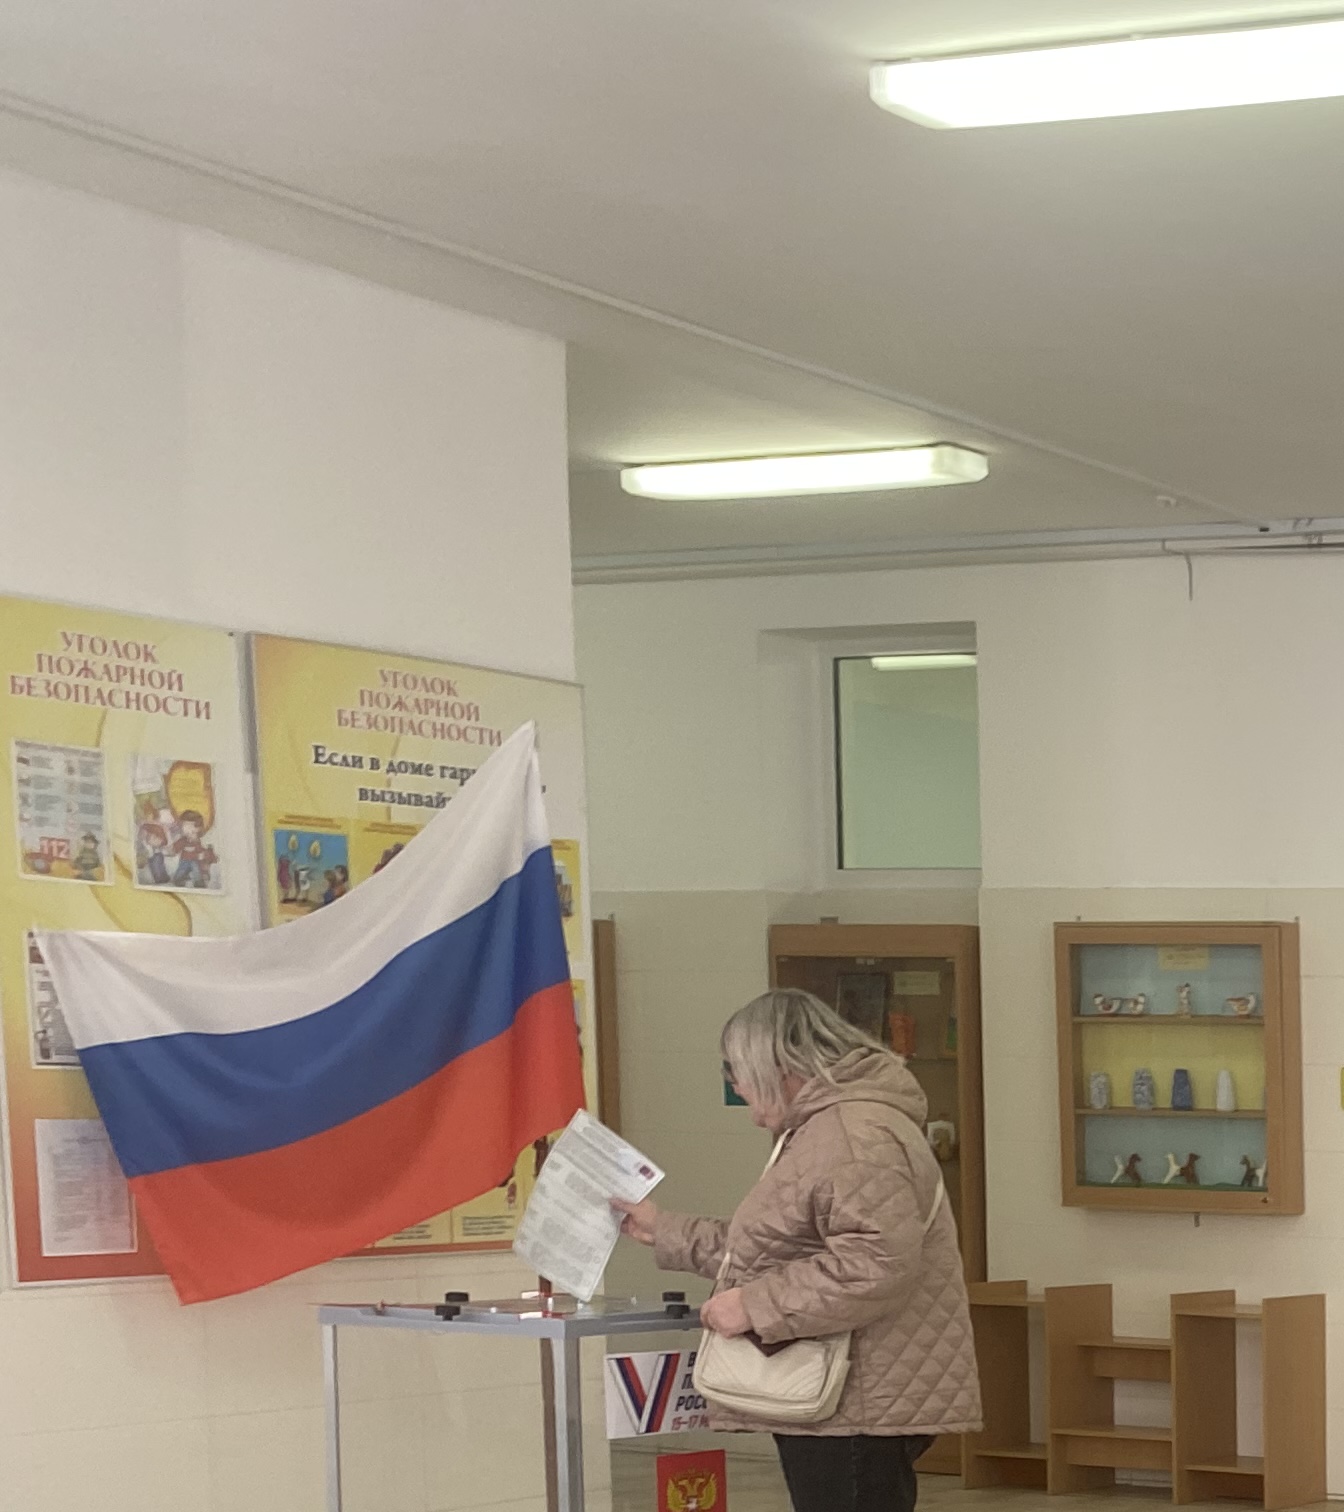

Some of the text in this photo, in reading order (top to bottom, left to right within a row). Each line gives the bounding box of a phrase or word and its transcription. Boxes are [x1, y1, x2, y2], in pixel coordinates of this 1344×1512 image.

[60, 631, 159, 665] УГОЛОК
[36, 653, 184, 692] ПОЖАРНОЙ
[378, 669, 459, 697] УГОЛОК
[10, 675, 212, 720] БЕЗОПАСНОСТИ
[359, 689, 480, 722] ПОЖАРНОЙ
[336, 708, 502, 747] БЕЗОПАСНОСТИ
[312, 744, 476, 786] Если в доме гар
[358, 788, 452, 809] вызывай
